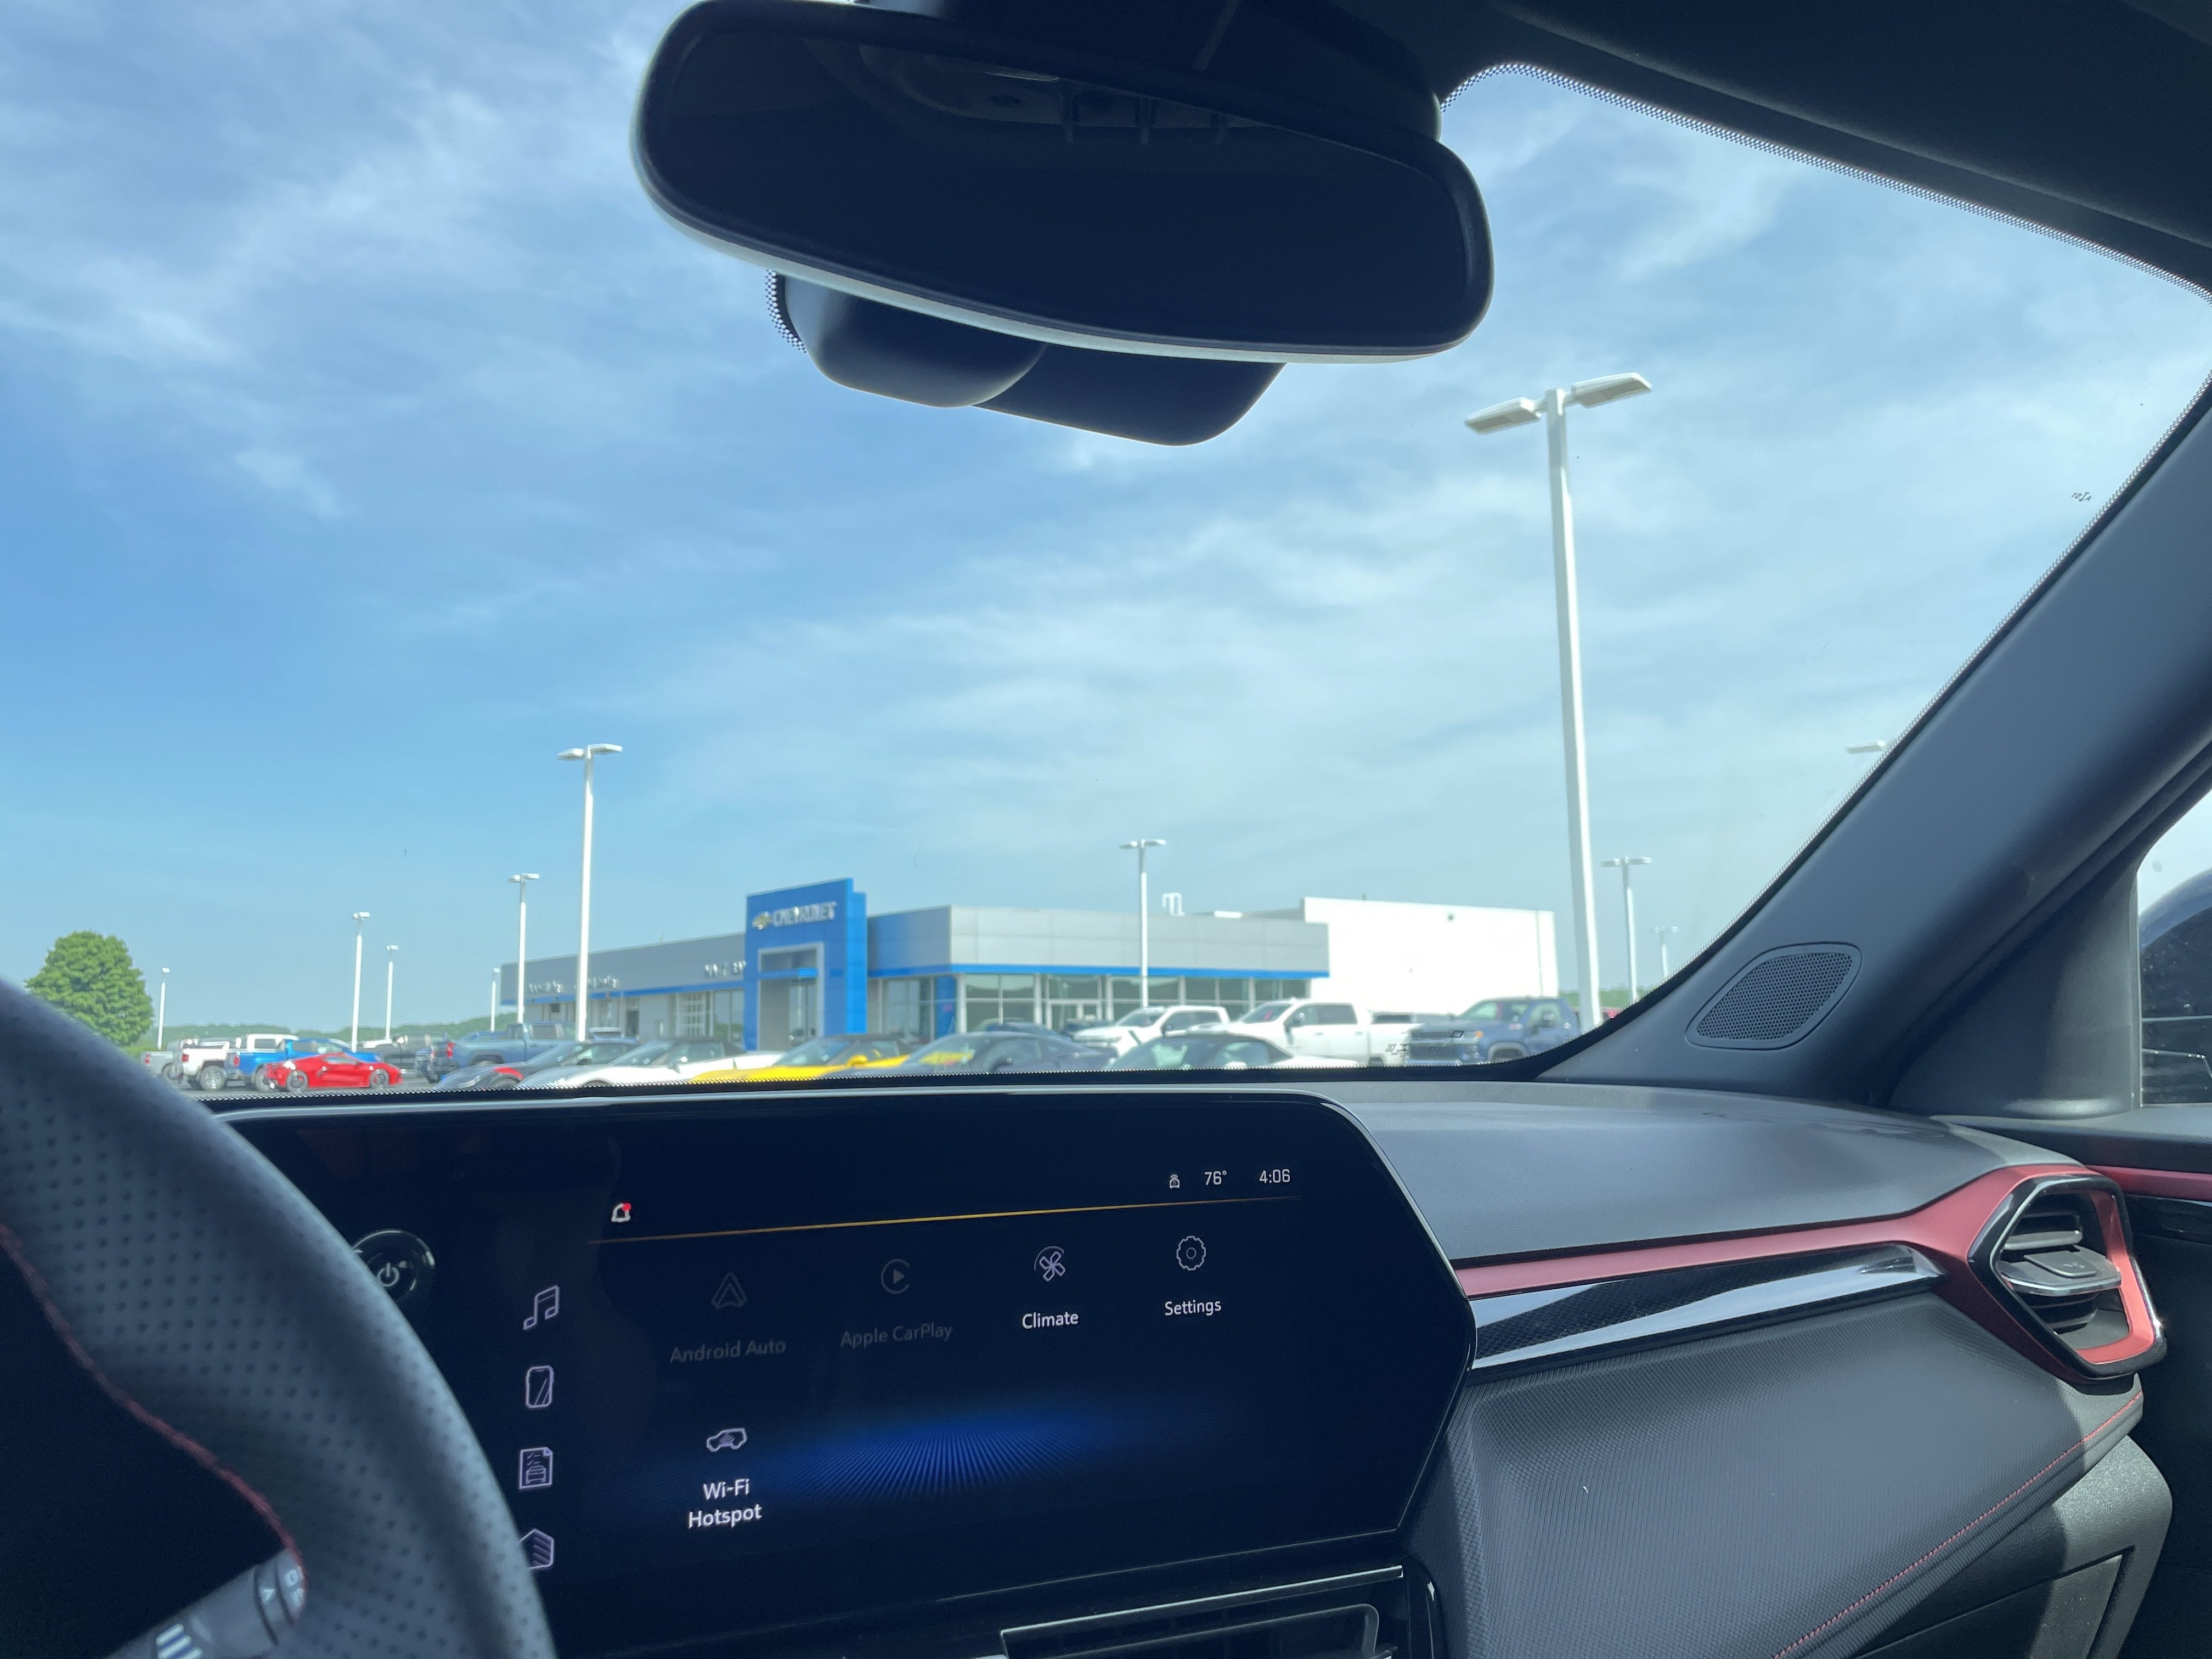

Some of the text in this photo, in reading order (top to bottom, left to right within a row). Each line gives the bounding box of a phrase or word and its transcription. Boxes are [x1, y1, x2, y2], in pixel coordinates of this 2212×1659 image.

[773, 901, 836, 928] CHEVROLET
[1259, 1169, 1290, 1184] 4:06
[1165, 1299, 1222, 1316] Settings
[1022, 1311, 1079, 1329] Climate
[840, 1322, 952, 1350] Apple CarPlay
[669, 1339, 787, 1363] Android Auto
[703, 1478, 750, 1500] Wi-Fi
[689, 1504, 763, 1529] Hotspot
